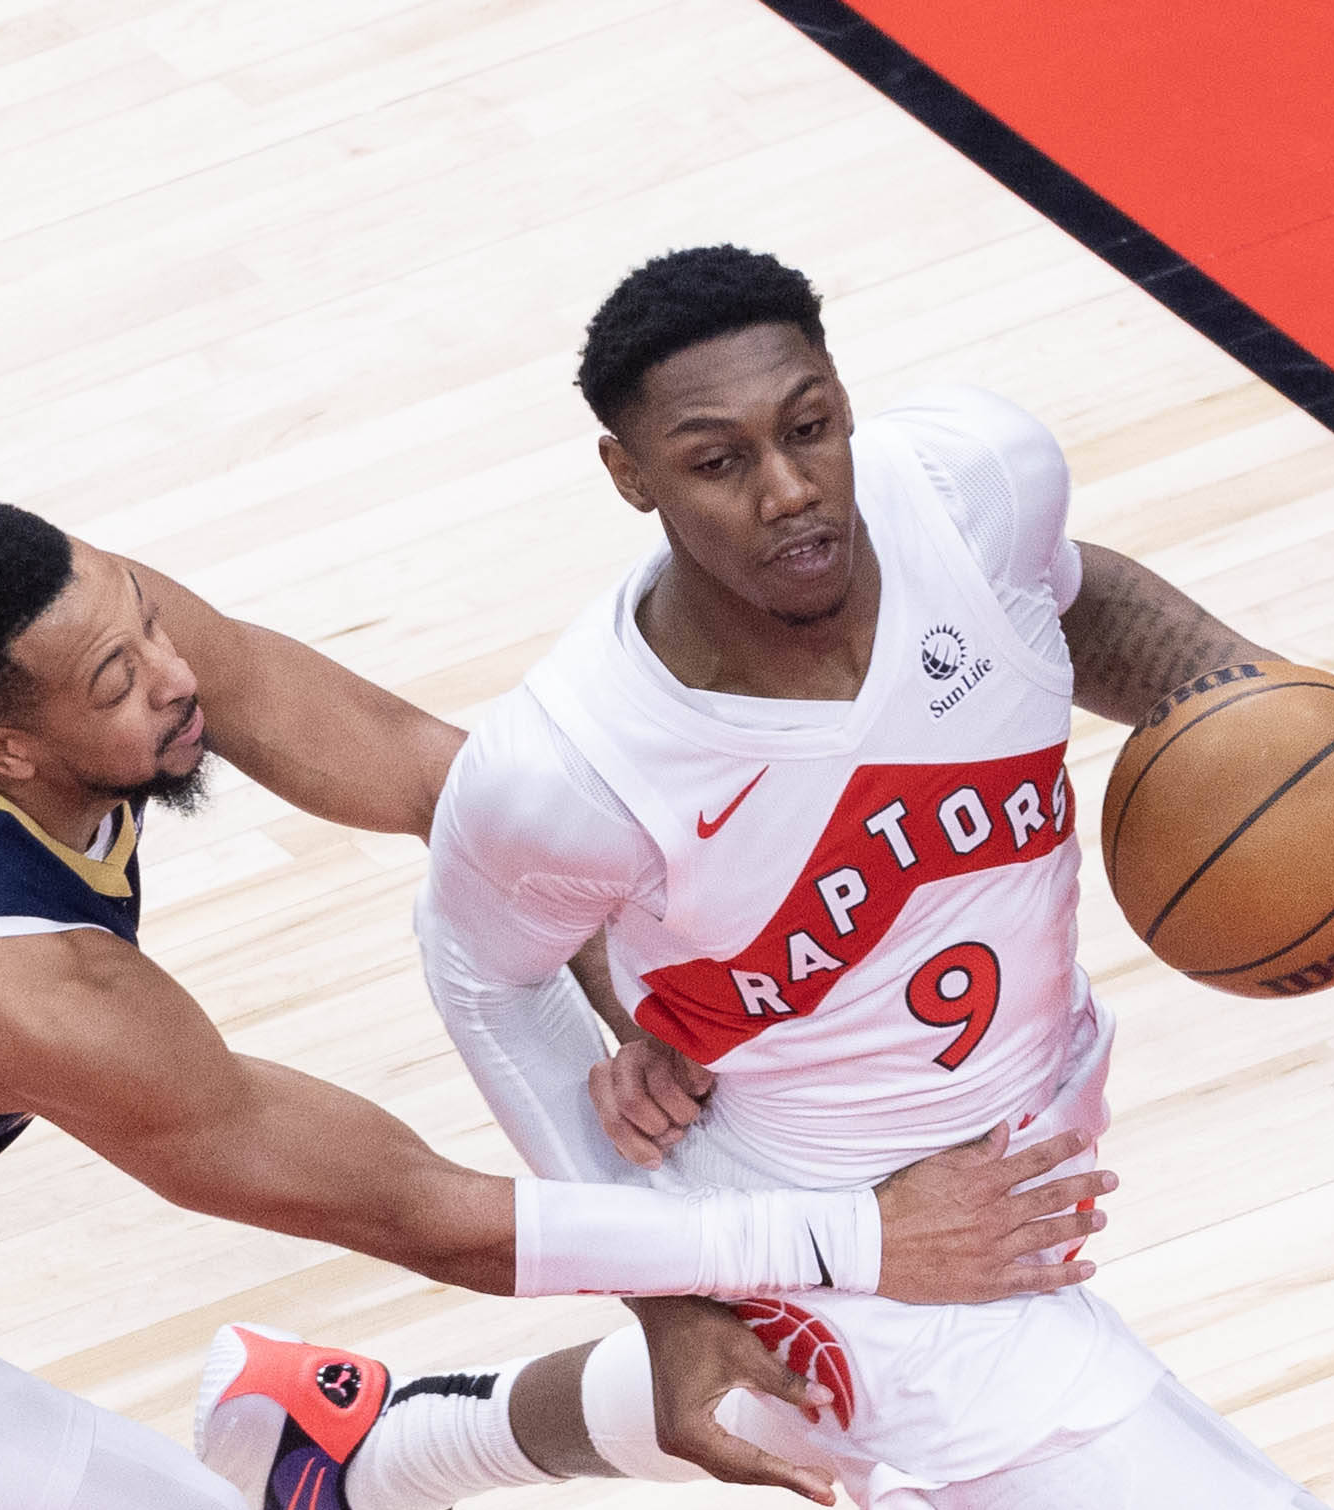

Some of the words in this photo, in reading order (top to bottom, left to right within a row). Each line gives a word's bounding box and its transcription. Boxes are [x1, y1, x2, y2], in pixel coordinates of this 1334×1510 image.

[929, 686, 966, 719] Sun
[960, 658, 994, 691] Life
[727, 760, 1068, 1018] RAPTORS
[904, 941, 1002, 1072] 9
